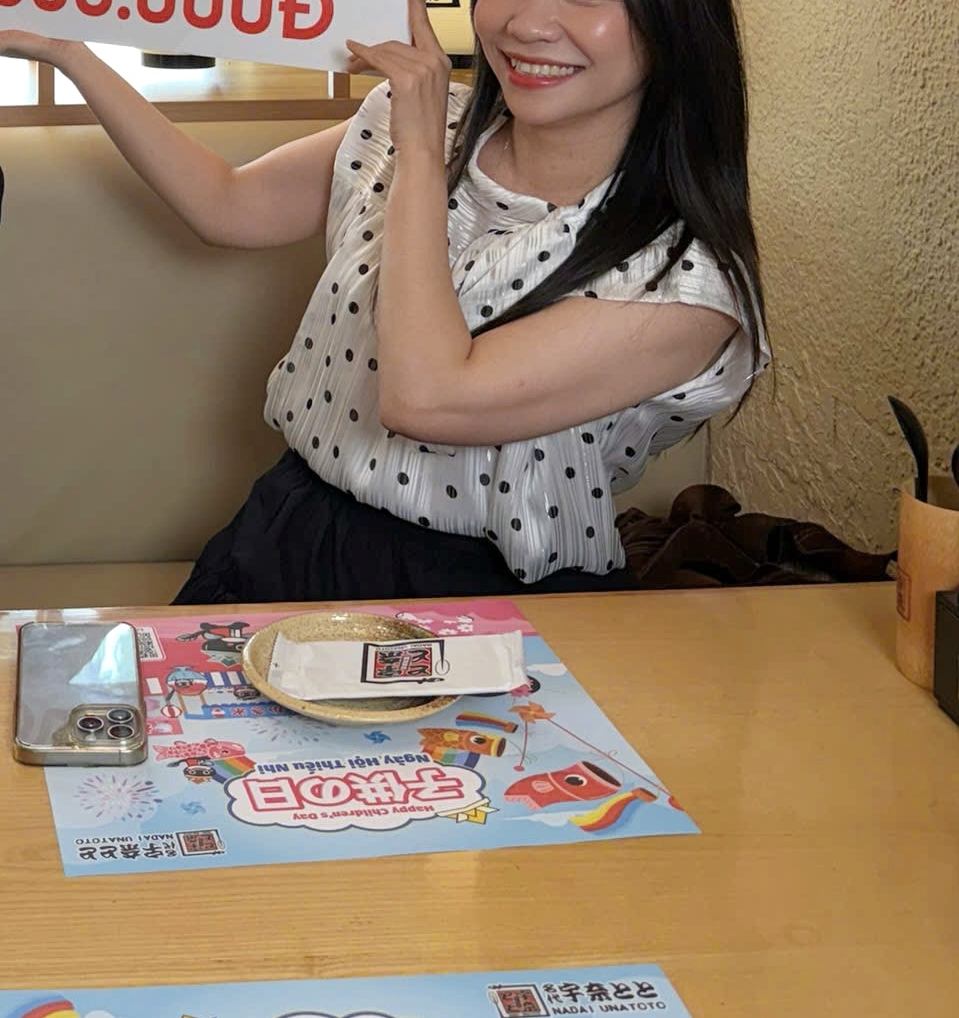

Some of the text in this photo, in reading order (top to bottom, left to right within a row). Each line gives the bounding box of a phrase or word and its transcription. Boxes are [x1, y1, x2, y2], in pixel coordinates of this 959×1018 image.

[257, 753, 430, 775] Ngày Hội Thiếu Nhi
[243, 767, 465, 813] 子供の日
[293, 805, 435, 821] Happy Children's Day
[75, 833, 174, 845] NADAI UNATOTO
[79, 842, 164, 860] 宇奈とと
[558, 981, 658, 1002] 宇奈とと
[552, 1001, 667, 1016] NADAI UNATOTO
